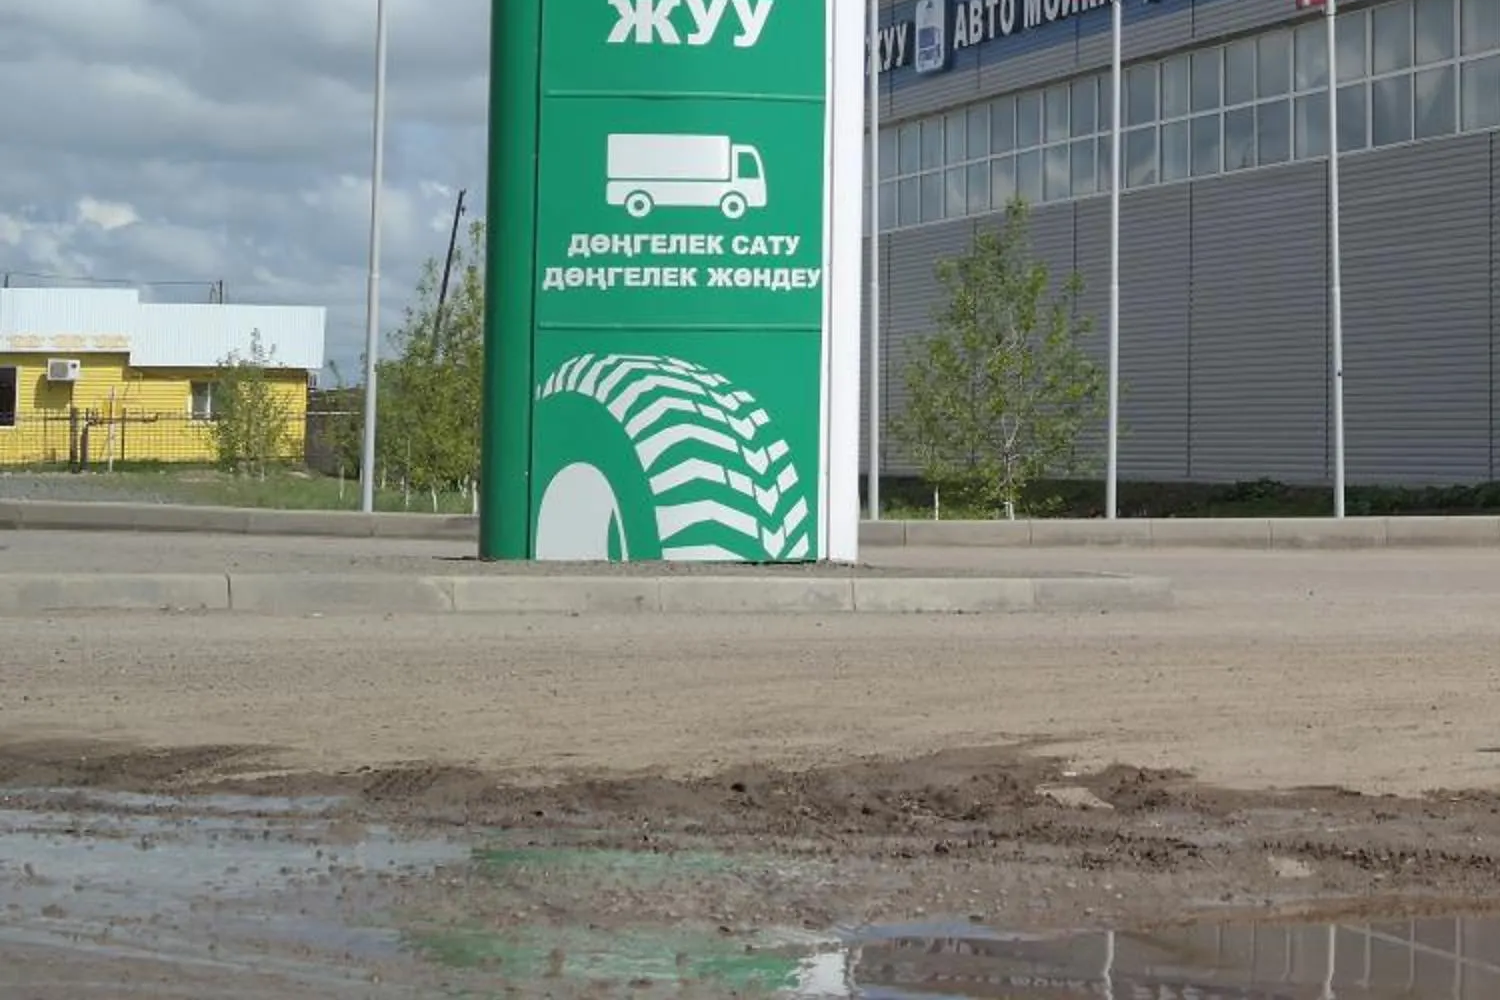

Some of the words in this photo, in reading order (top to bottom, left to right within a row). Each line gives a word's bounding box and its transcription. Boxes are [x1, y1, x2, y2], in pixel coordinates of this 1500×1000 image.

[567, 233, 724, 257] ДӨҢГЕЛЕК
[731, 235, 801, 256] САТУ
[542, 267, 698, 290] ДӨҢГЕЛЕК
[707, 267, 821, 291] ЖӨНДЕУ
